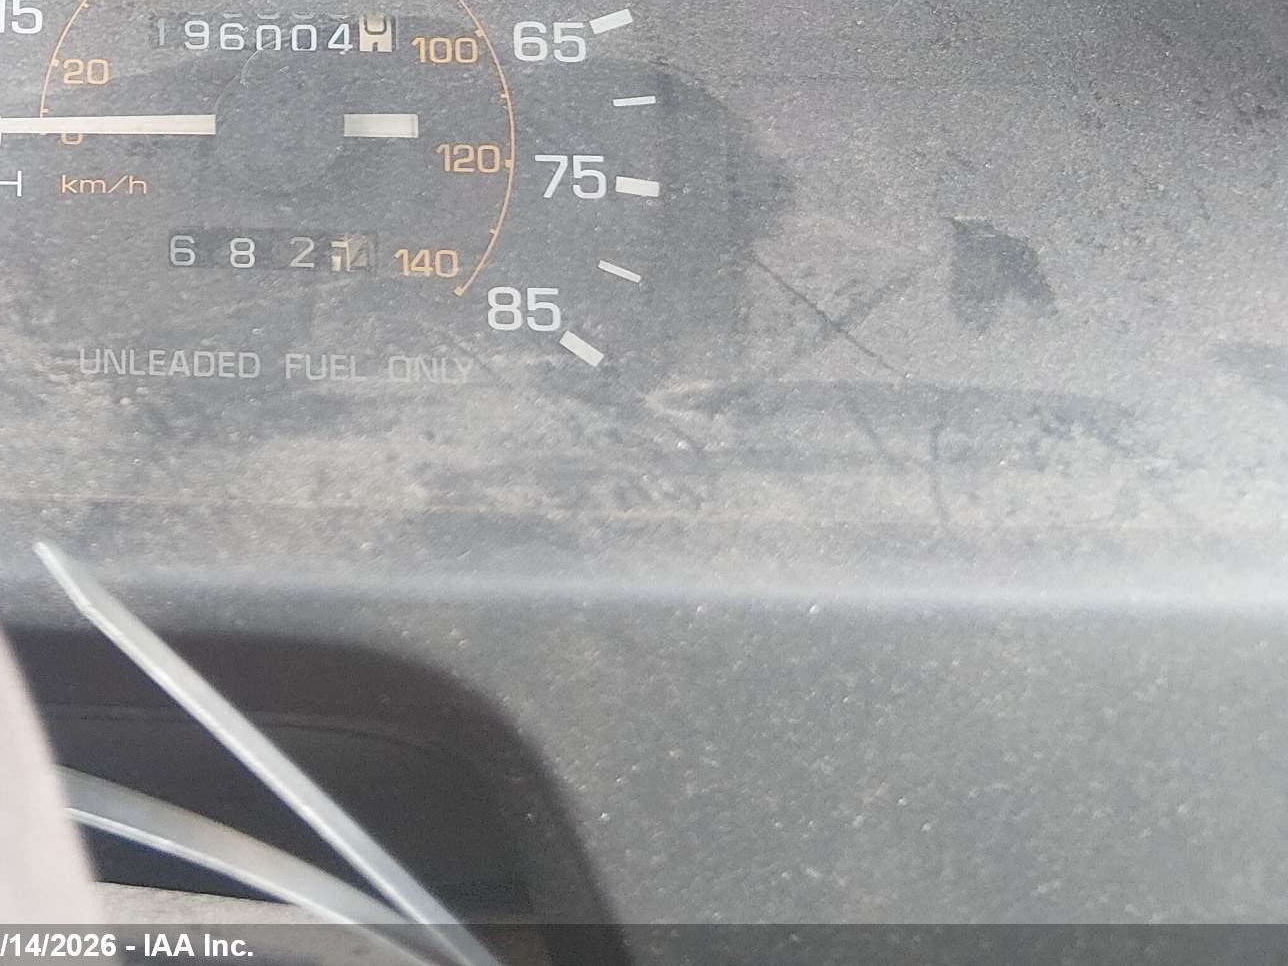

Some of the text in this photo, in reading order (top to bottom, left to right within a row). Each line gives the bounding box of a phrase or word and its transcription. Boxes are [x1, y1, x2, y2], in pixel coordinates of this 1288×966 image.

[412, 37, 479, 65] 100
[514, 22, 586, 63] 65
[63, 58, 109, 86] 20
[436, 144, 501, 173] 120
[60, 174, 148, 195] km/h
[535, 156, 607, 200] 75
[394, 248, 460, 278] 140
[488, 288, 561, 332] 85
[79, 348, 474, 385] UNLEADED FUEL ONLY
